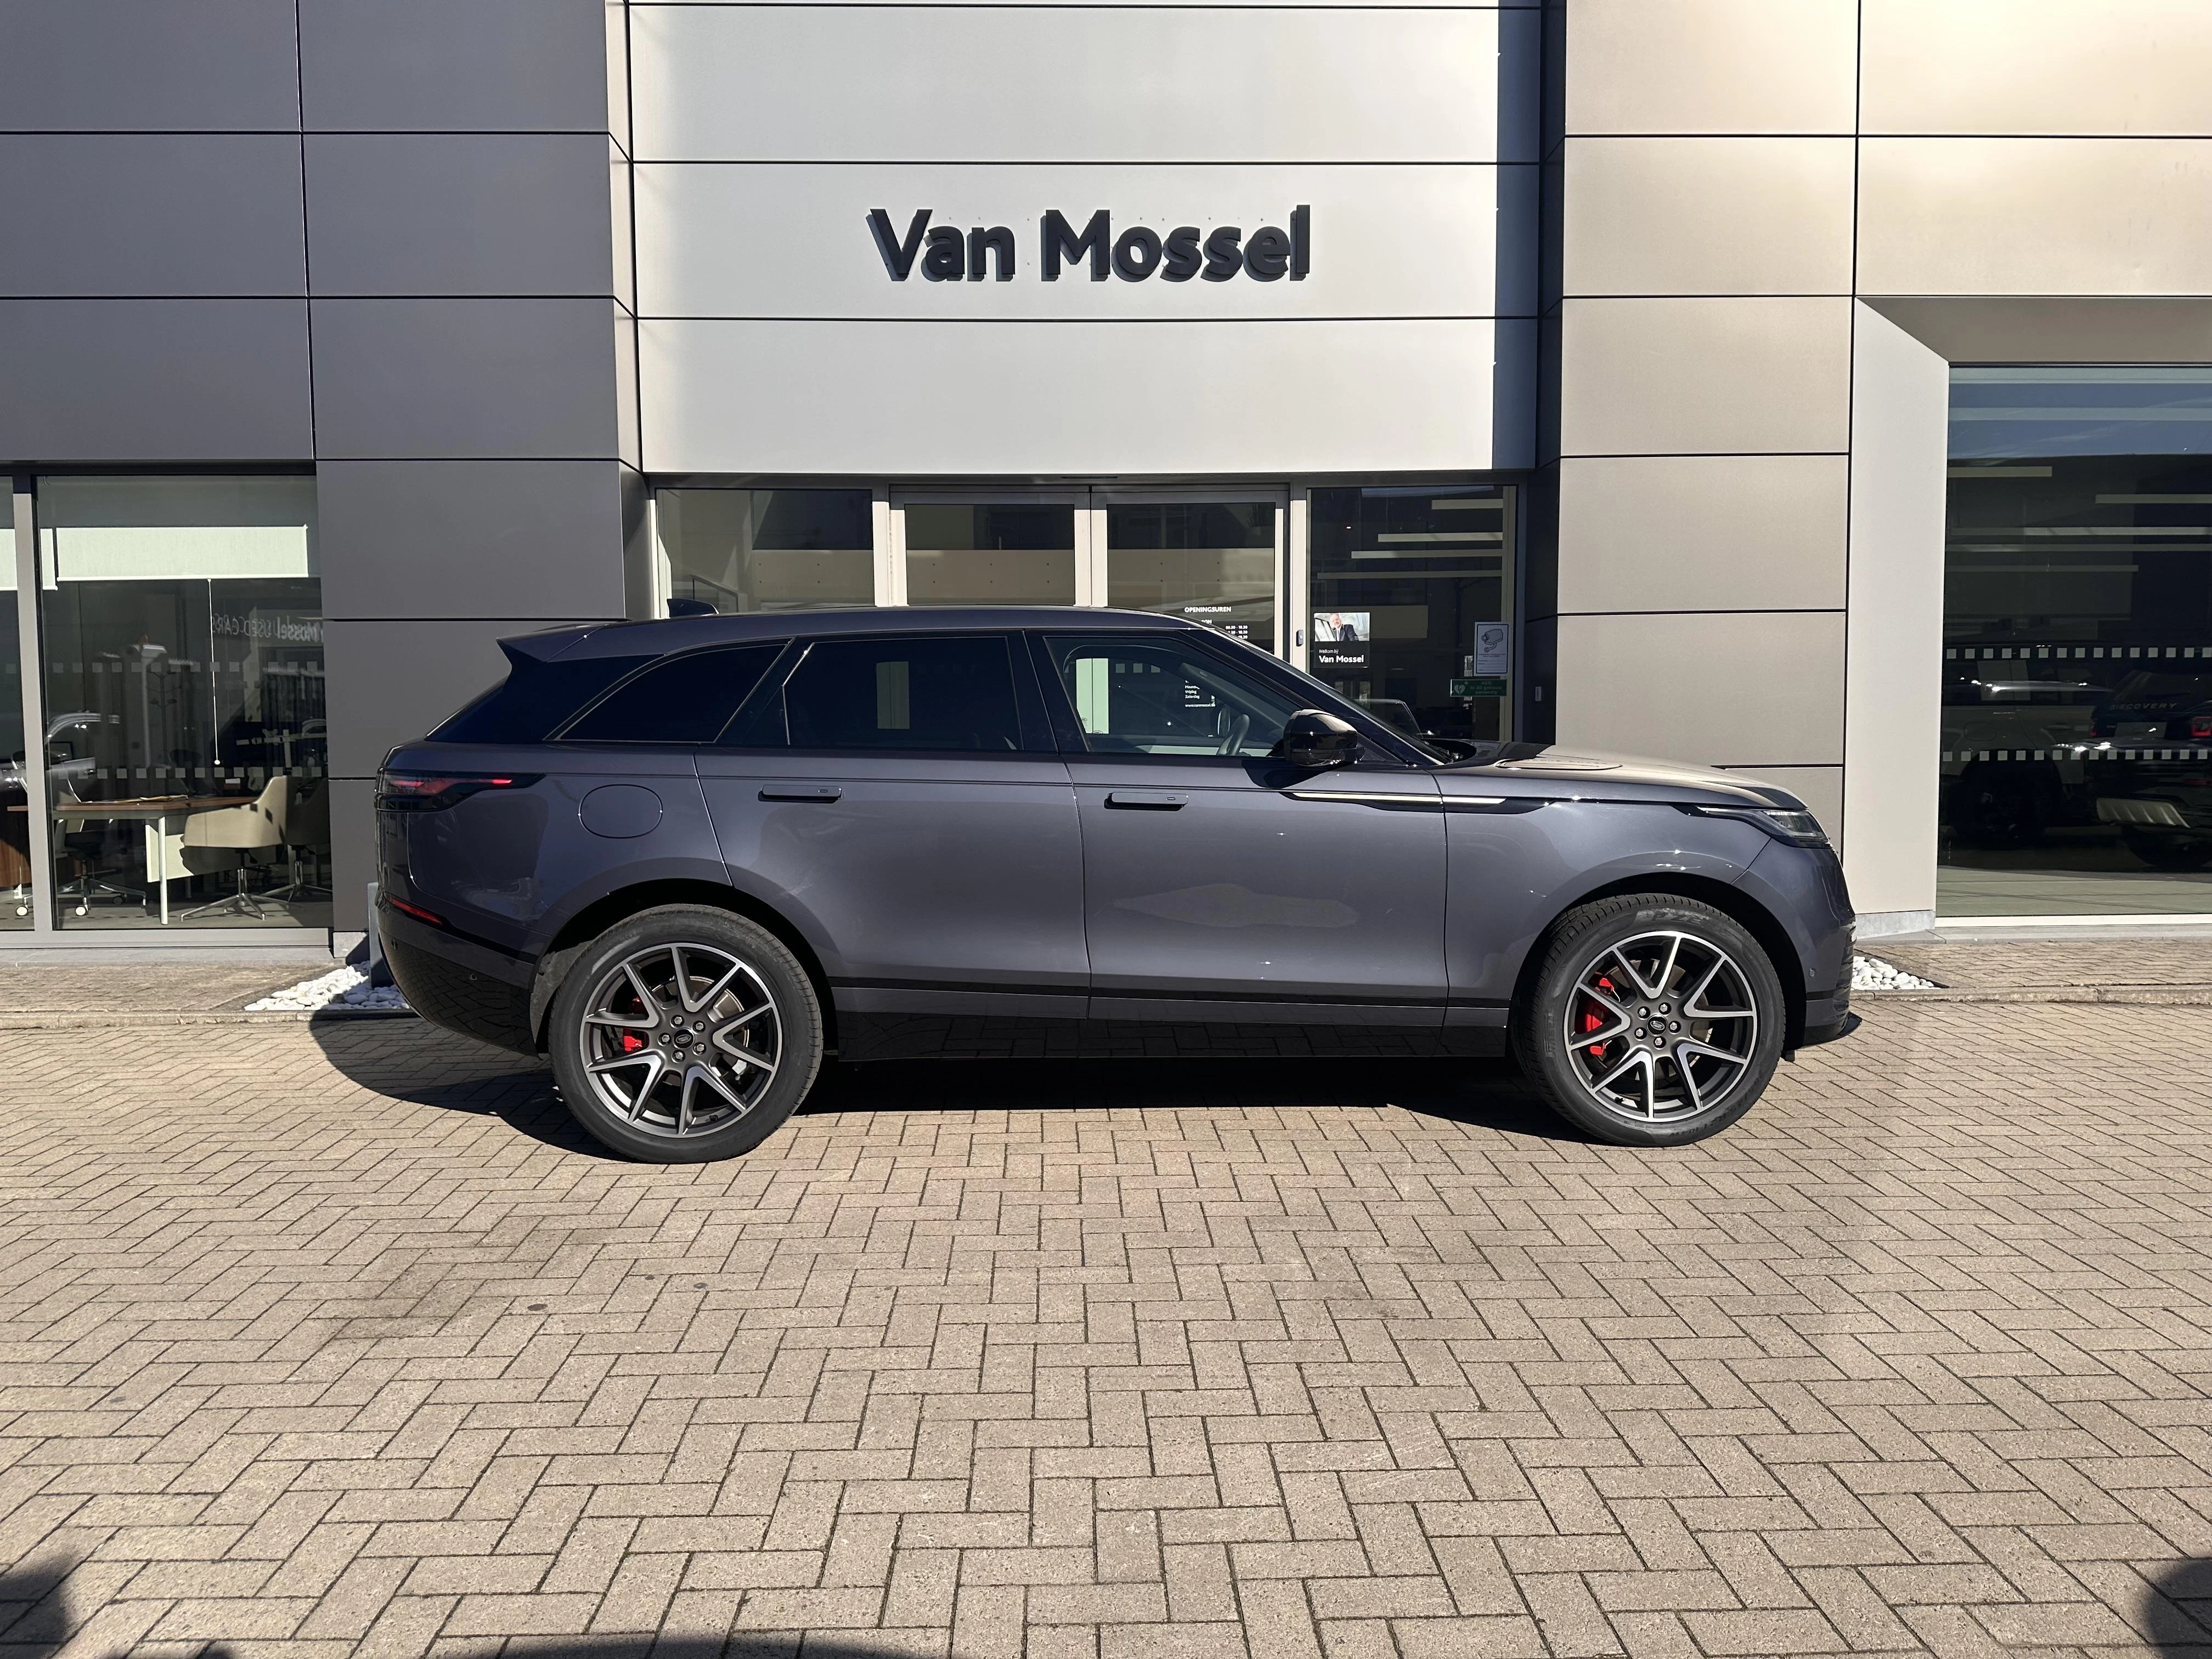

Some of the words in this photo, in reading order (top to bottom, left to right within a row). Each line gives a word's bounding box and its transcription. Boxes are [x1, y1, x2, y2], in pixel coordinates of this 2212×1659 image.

[867, 208, 1015, 280] Van
[1042, 205, 1311, 280] Mossel
[1336, 654, 1364, 663] Mossel
